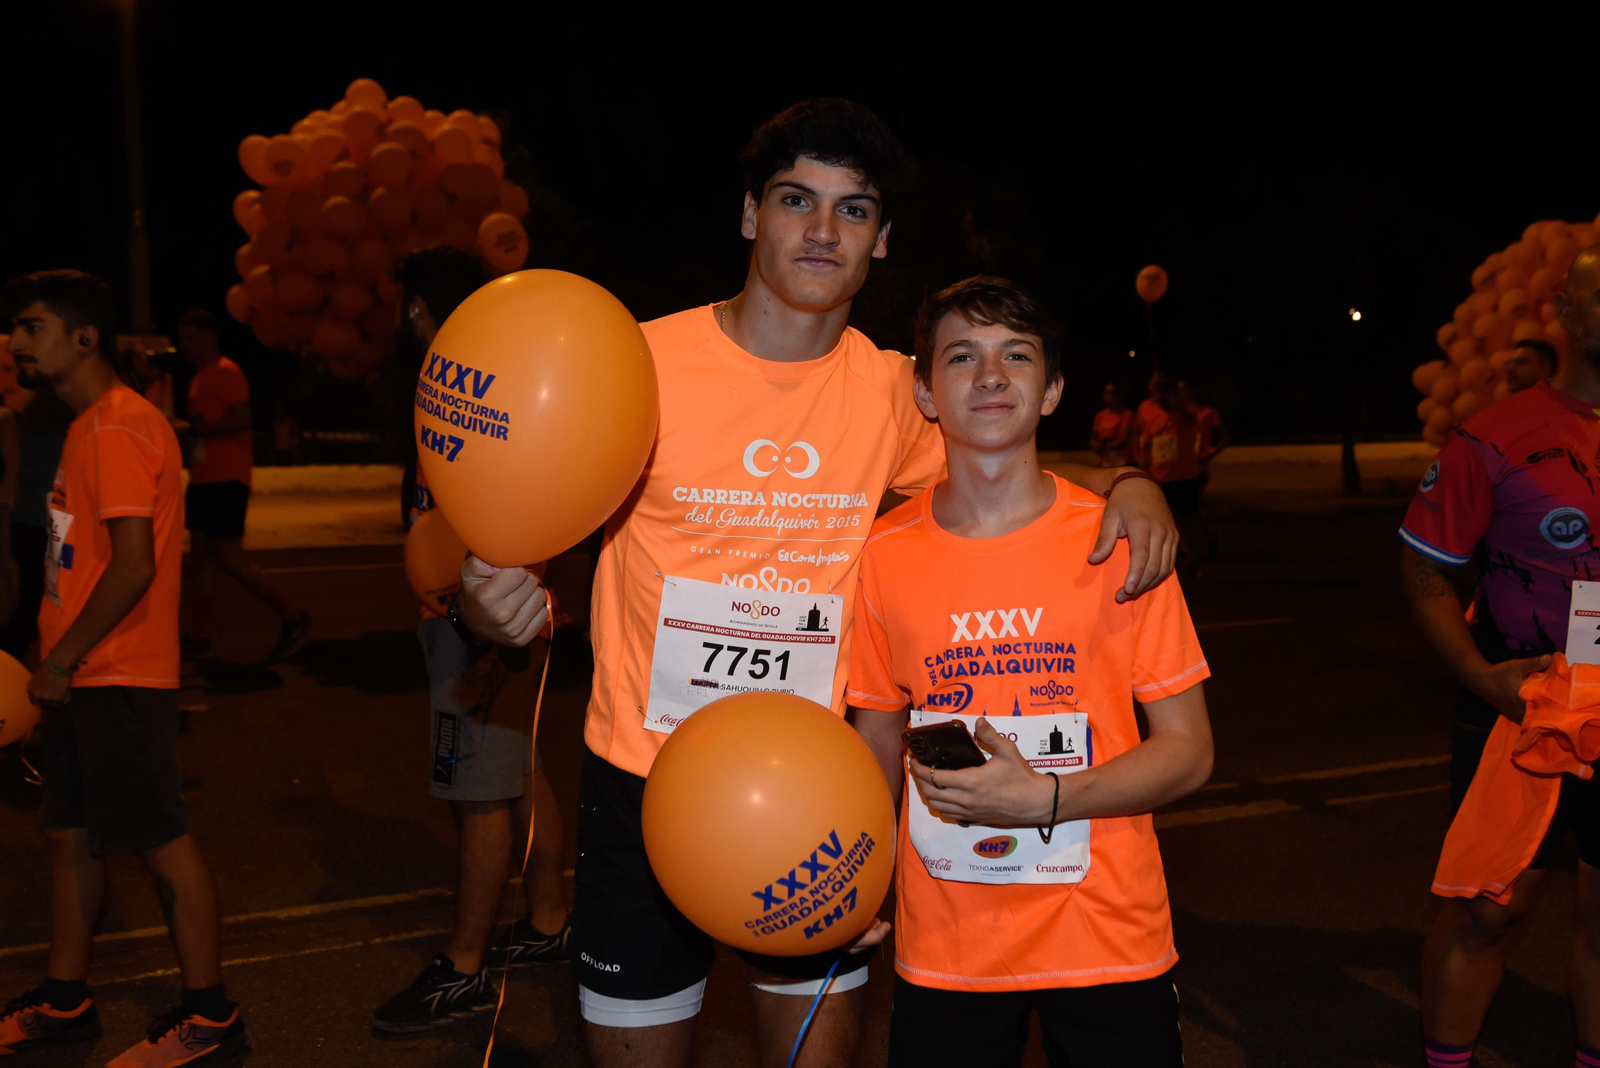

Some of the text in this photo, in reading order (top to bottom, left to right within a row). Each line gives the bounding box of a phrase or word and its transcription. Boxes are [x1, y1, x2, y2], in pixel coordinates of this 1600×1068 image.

[424, 352, 496, 400] XXXV
[440, 392, 510, 424] NOCTURNA
[672, 486, 869, 509] CARRERA NOCTURNA
[685, 505, 861, 536] del Guadalquivir 2015
[1551, 519, 1584, 536] ap
[690, 545, 721, 555] GRAN
[728, 548, 771, 560] PREMIO
[790, 550, 816, 564] Corte
[668, 619, 686, 629] XXXV
[686, 622, 715, 633] CARRERA
[715, 626, 750, 638] NOCTURNA
[763, 633, 806, 642] GUADALQUIVIR
[950, 607, 1044, 643] XXXV
[702, 641, 790, 681] 7751
[924, 642, 1077, 668] CARERA NOCTURNA
[939, 657, 1076, 680] UADALQUIVIR
[437, 718, 455, 758] PUMA
[744, 831, 869, 929] CARRERA NOCTURNA
[751, 829, 843, 913] XXXV
[760, 837, 876, 935] GUADALQUIVIR
[581, 952, 621, 973] OFFLOAD
